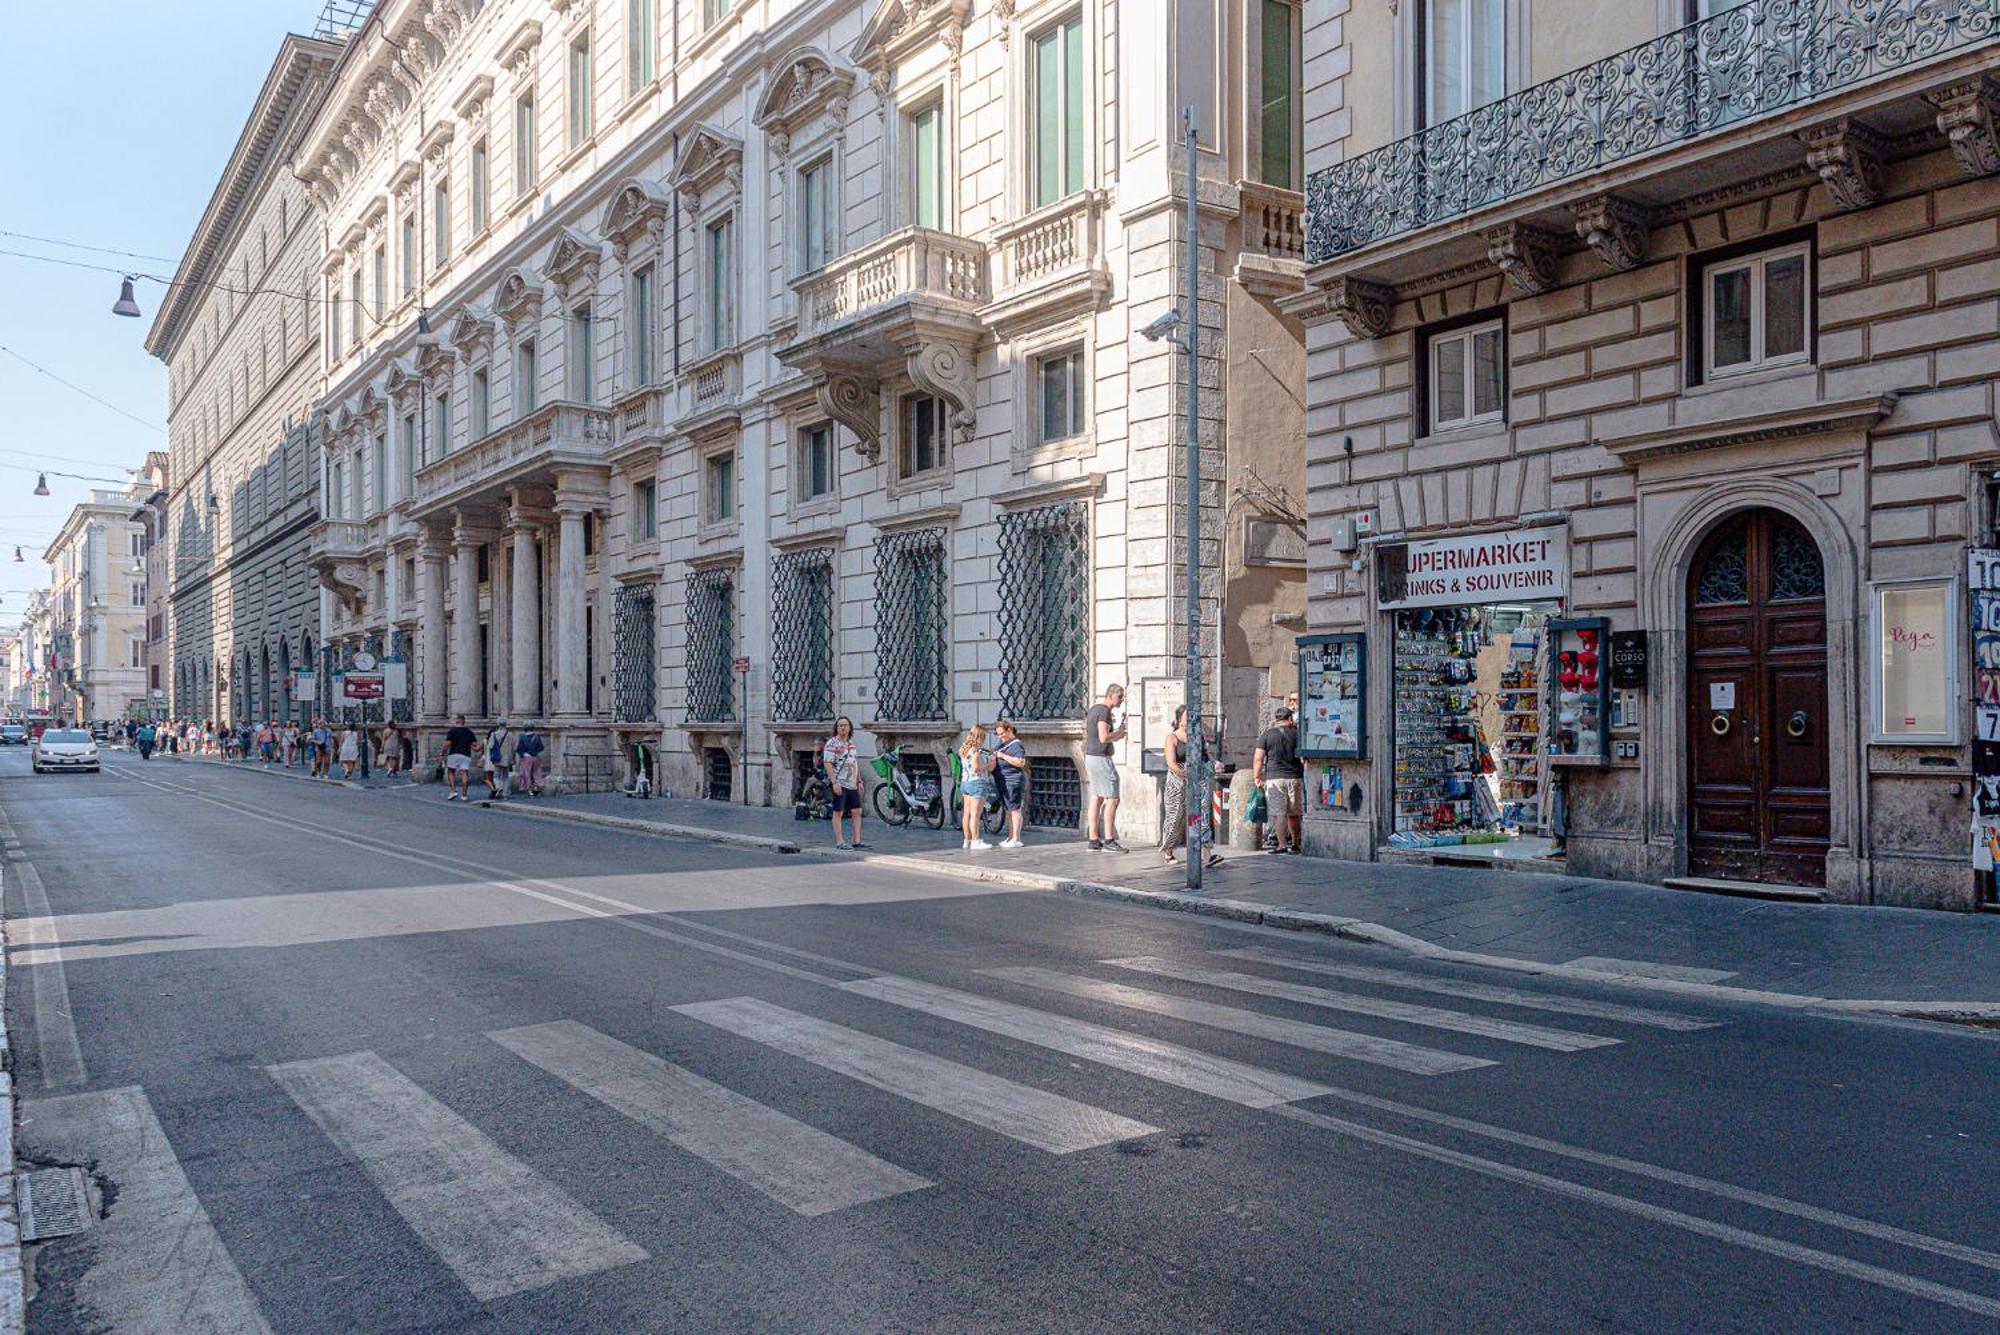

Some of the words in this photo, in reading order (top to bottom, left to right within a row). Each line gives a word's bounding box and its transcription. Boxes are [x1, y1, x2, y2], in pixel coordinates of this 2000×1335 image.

[1404, 540, 1551, 575] UPERMARKET
[1451, 578, 1461, 593] &
[1466, 569, 1553, 592] SOUVENIR
[1614, 652, 1645, 663] CORSO
[1986, 713, 1998, 739] 7
